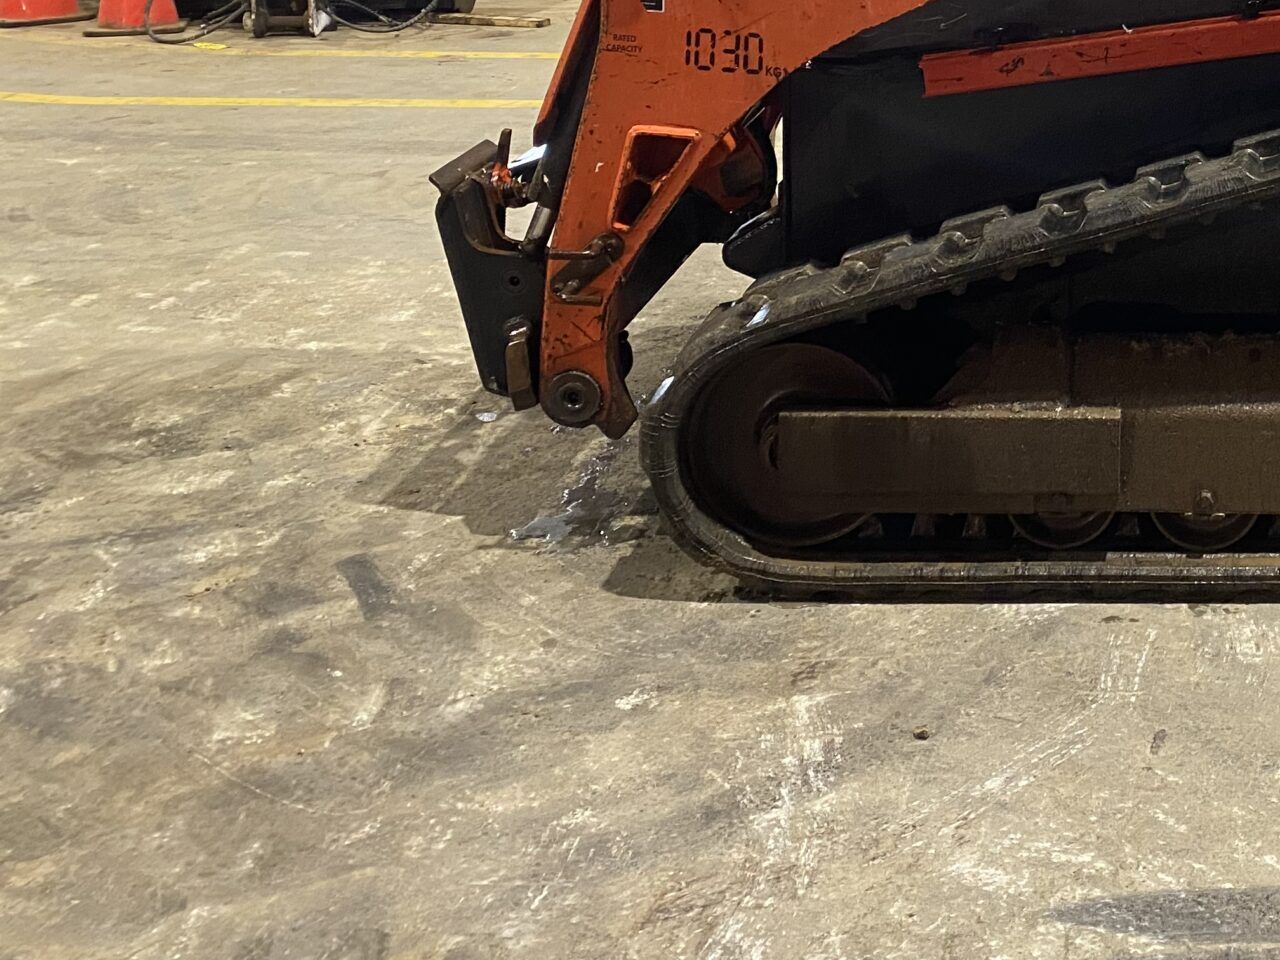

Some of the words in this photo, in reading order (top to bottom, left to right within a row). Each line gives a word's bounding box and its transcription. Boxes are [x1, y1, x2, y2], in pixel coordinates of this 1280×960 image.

[612, 33, 637, 43] RATED
[606, 43, 643, 53] CAPACITY
[685, 27, 764, 75] 1030
